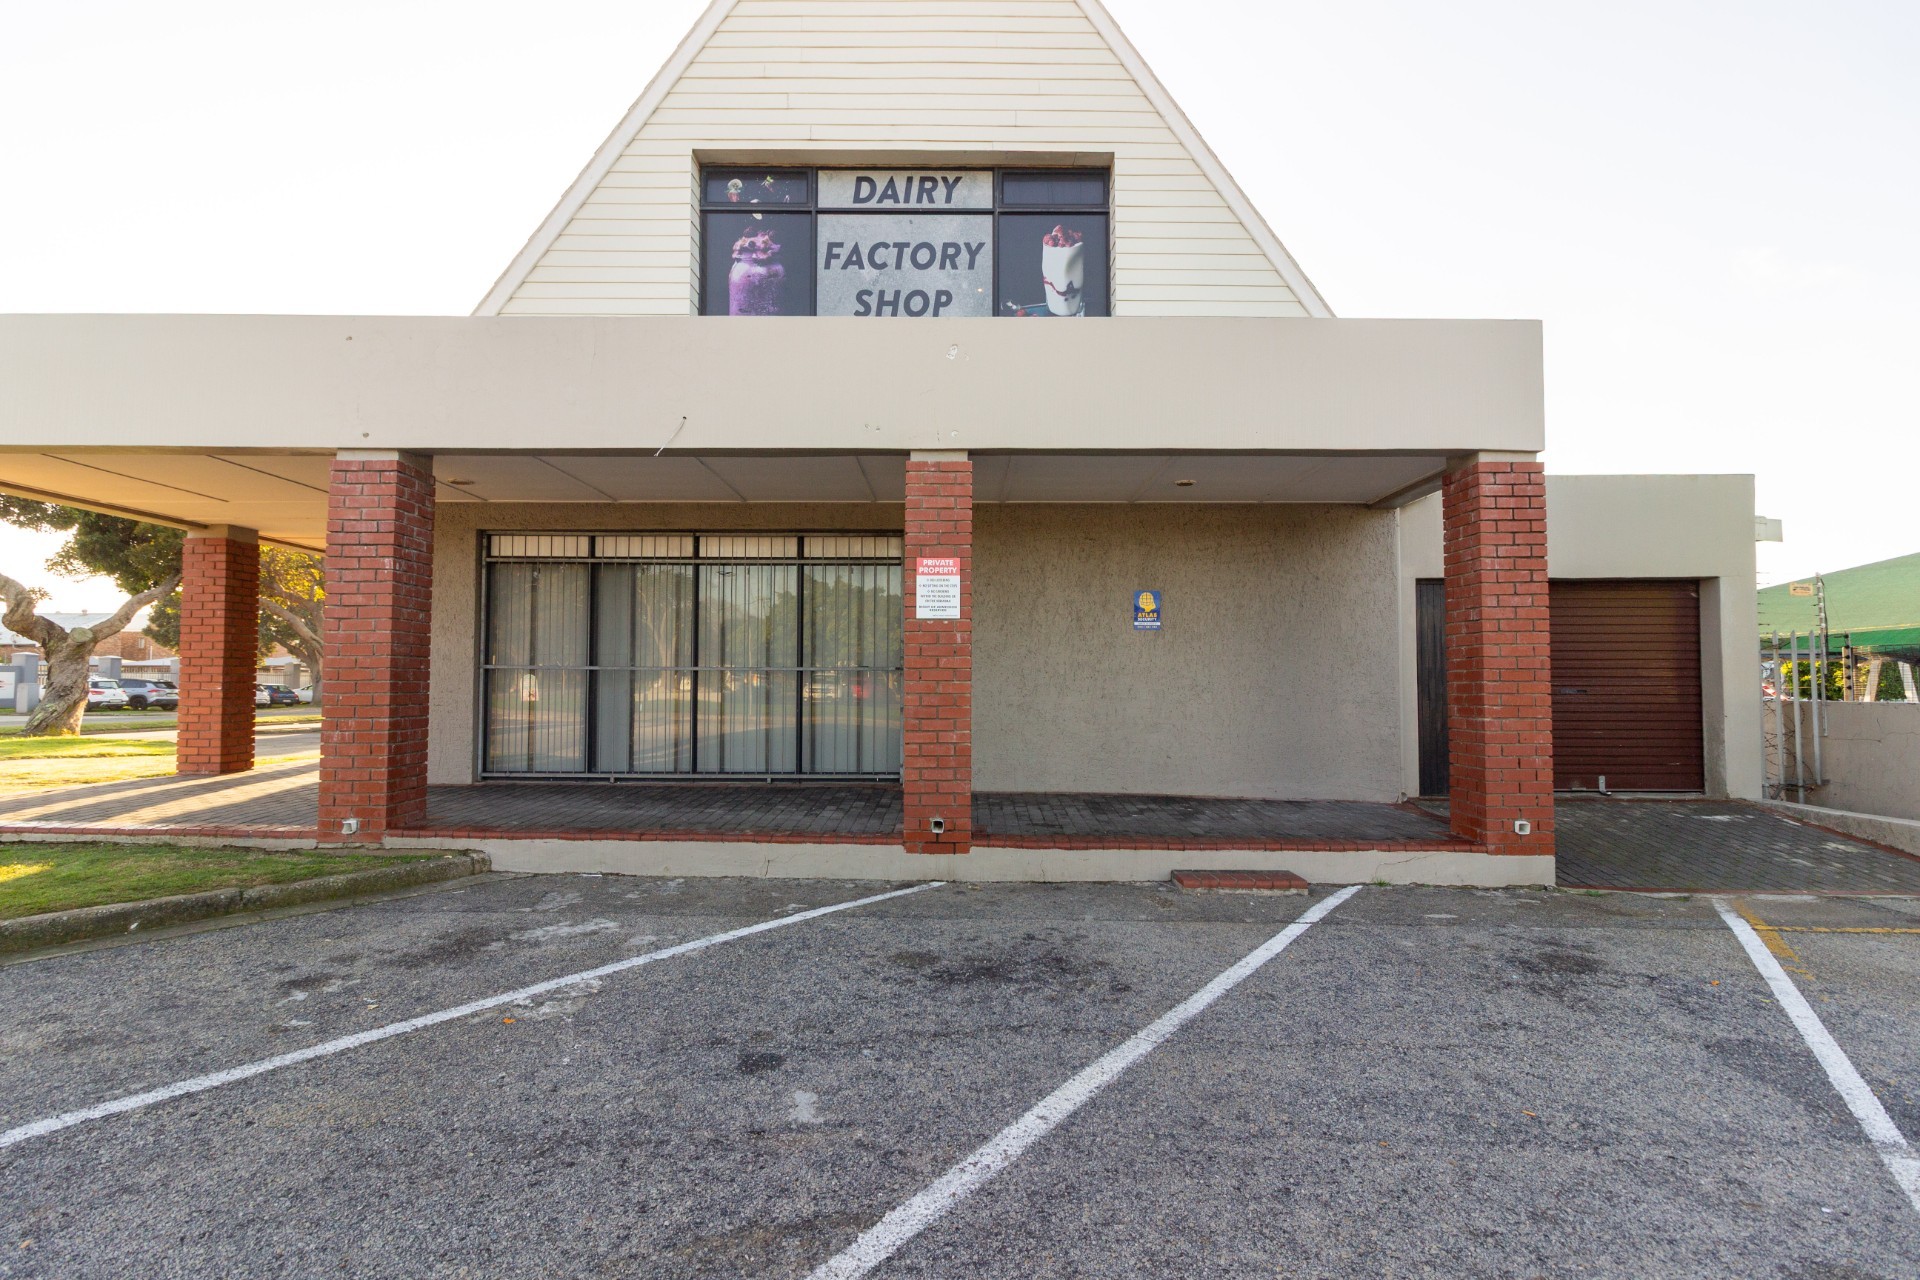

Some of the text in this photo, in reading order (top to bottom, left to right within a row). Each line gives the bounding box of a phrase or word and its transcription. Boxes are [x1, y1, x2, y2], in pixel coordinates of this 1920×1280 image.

[852, 175, 963, 205] DAIRY
[824, 241, 986, 271] FACTORY
[853, 289, 953, 318] SHOP
